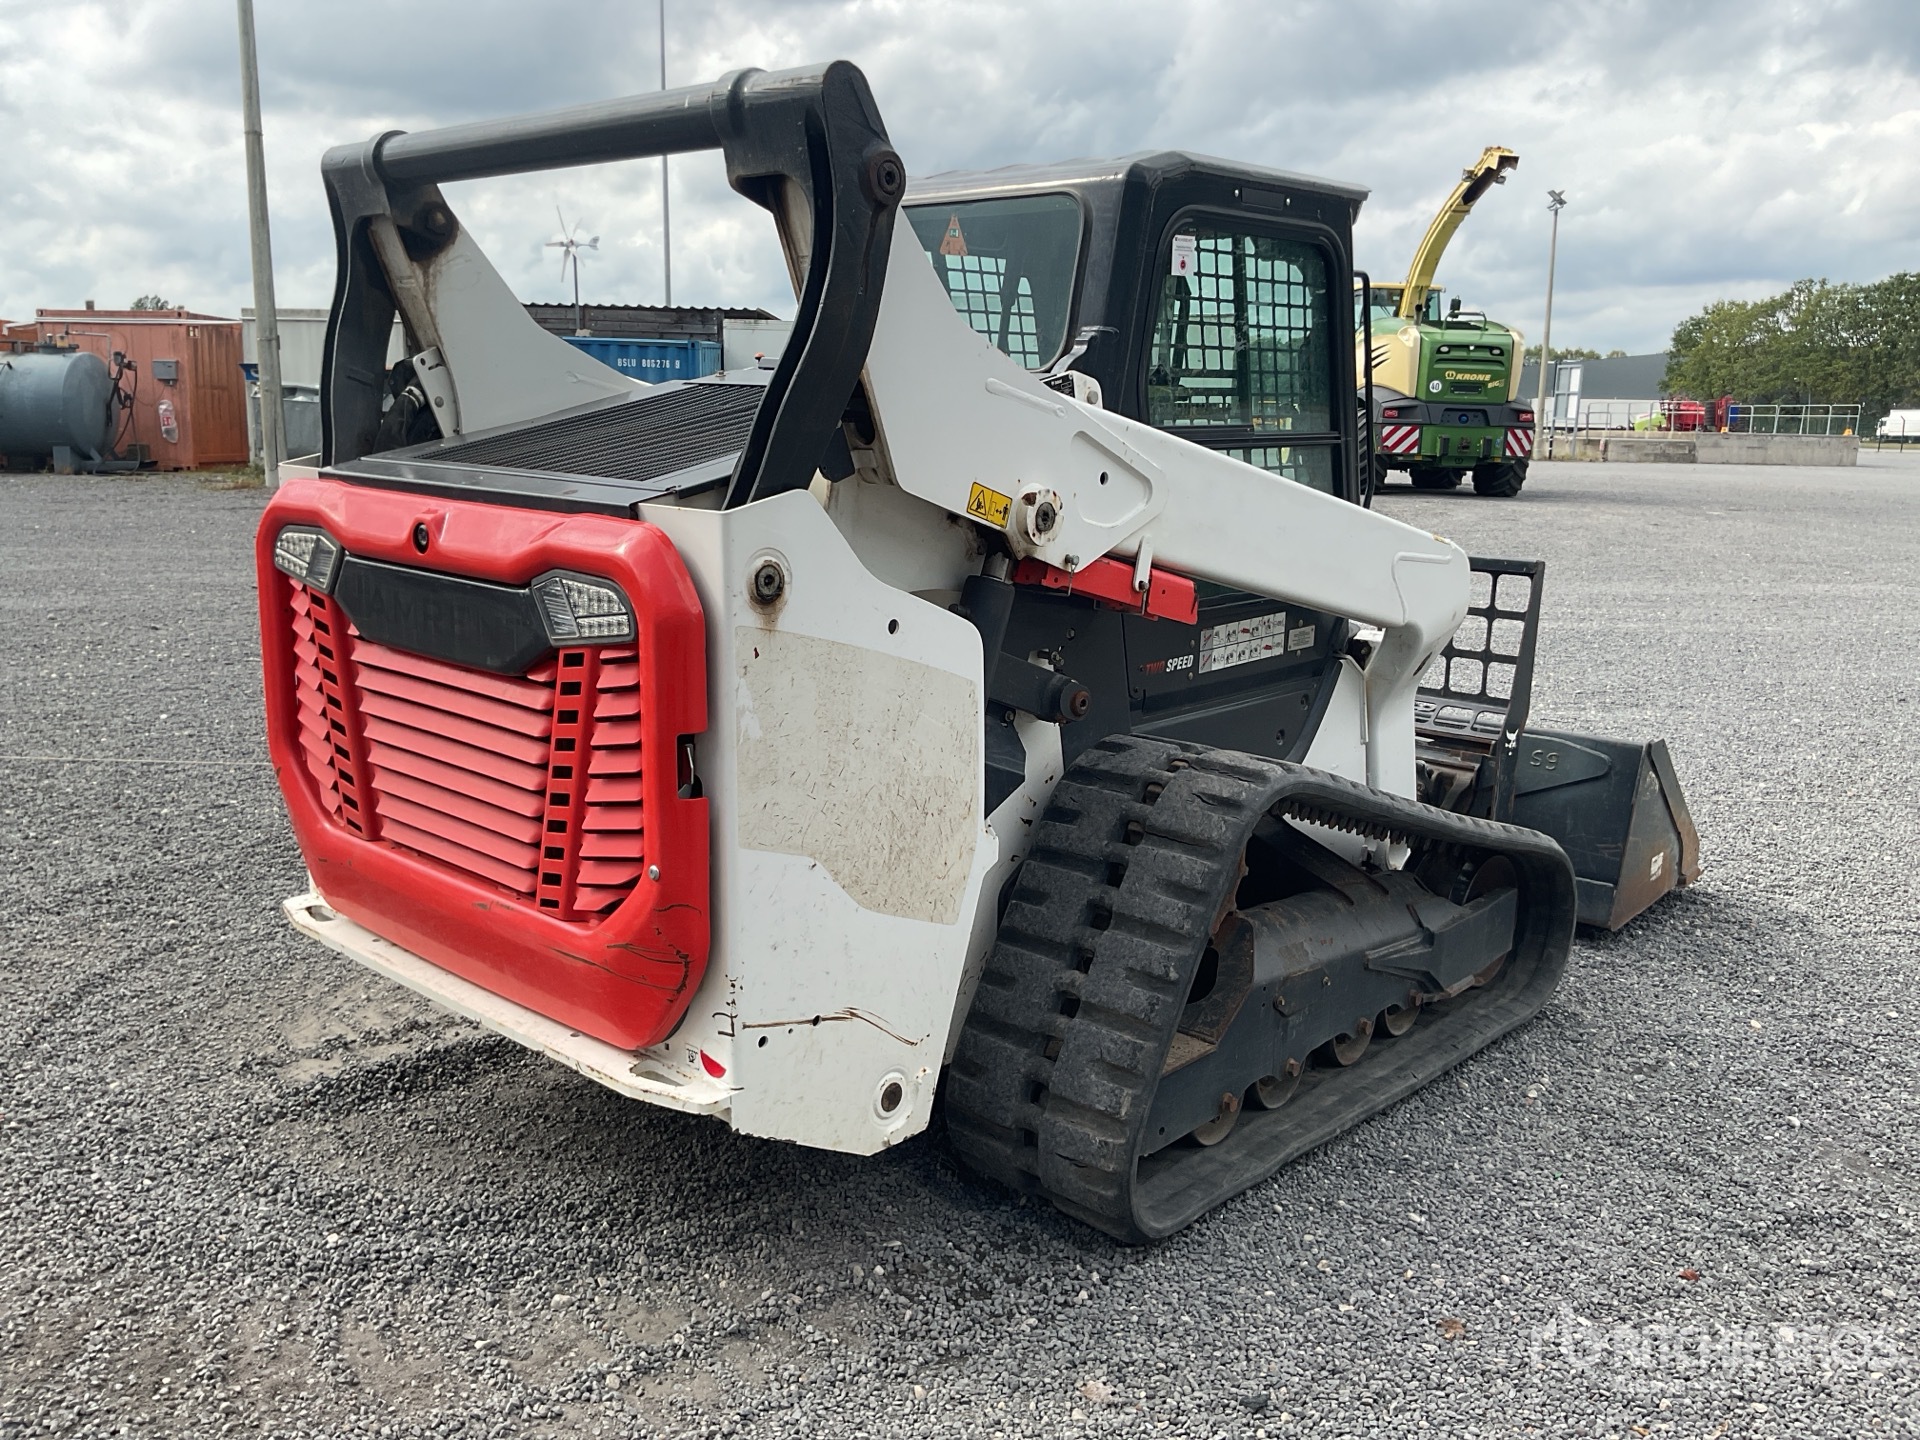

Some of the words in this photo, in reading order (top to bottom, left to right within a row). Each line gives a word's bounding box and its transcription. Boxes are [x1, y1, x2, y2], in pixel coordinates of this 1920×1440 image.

[1456, 373, 1491, 381] KRONE
[1145, 660, 1165, 675] TWO
[1166, 654, 1194, 672] SPEED
